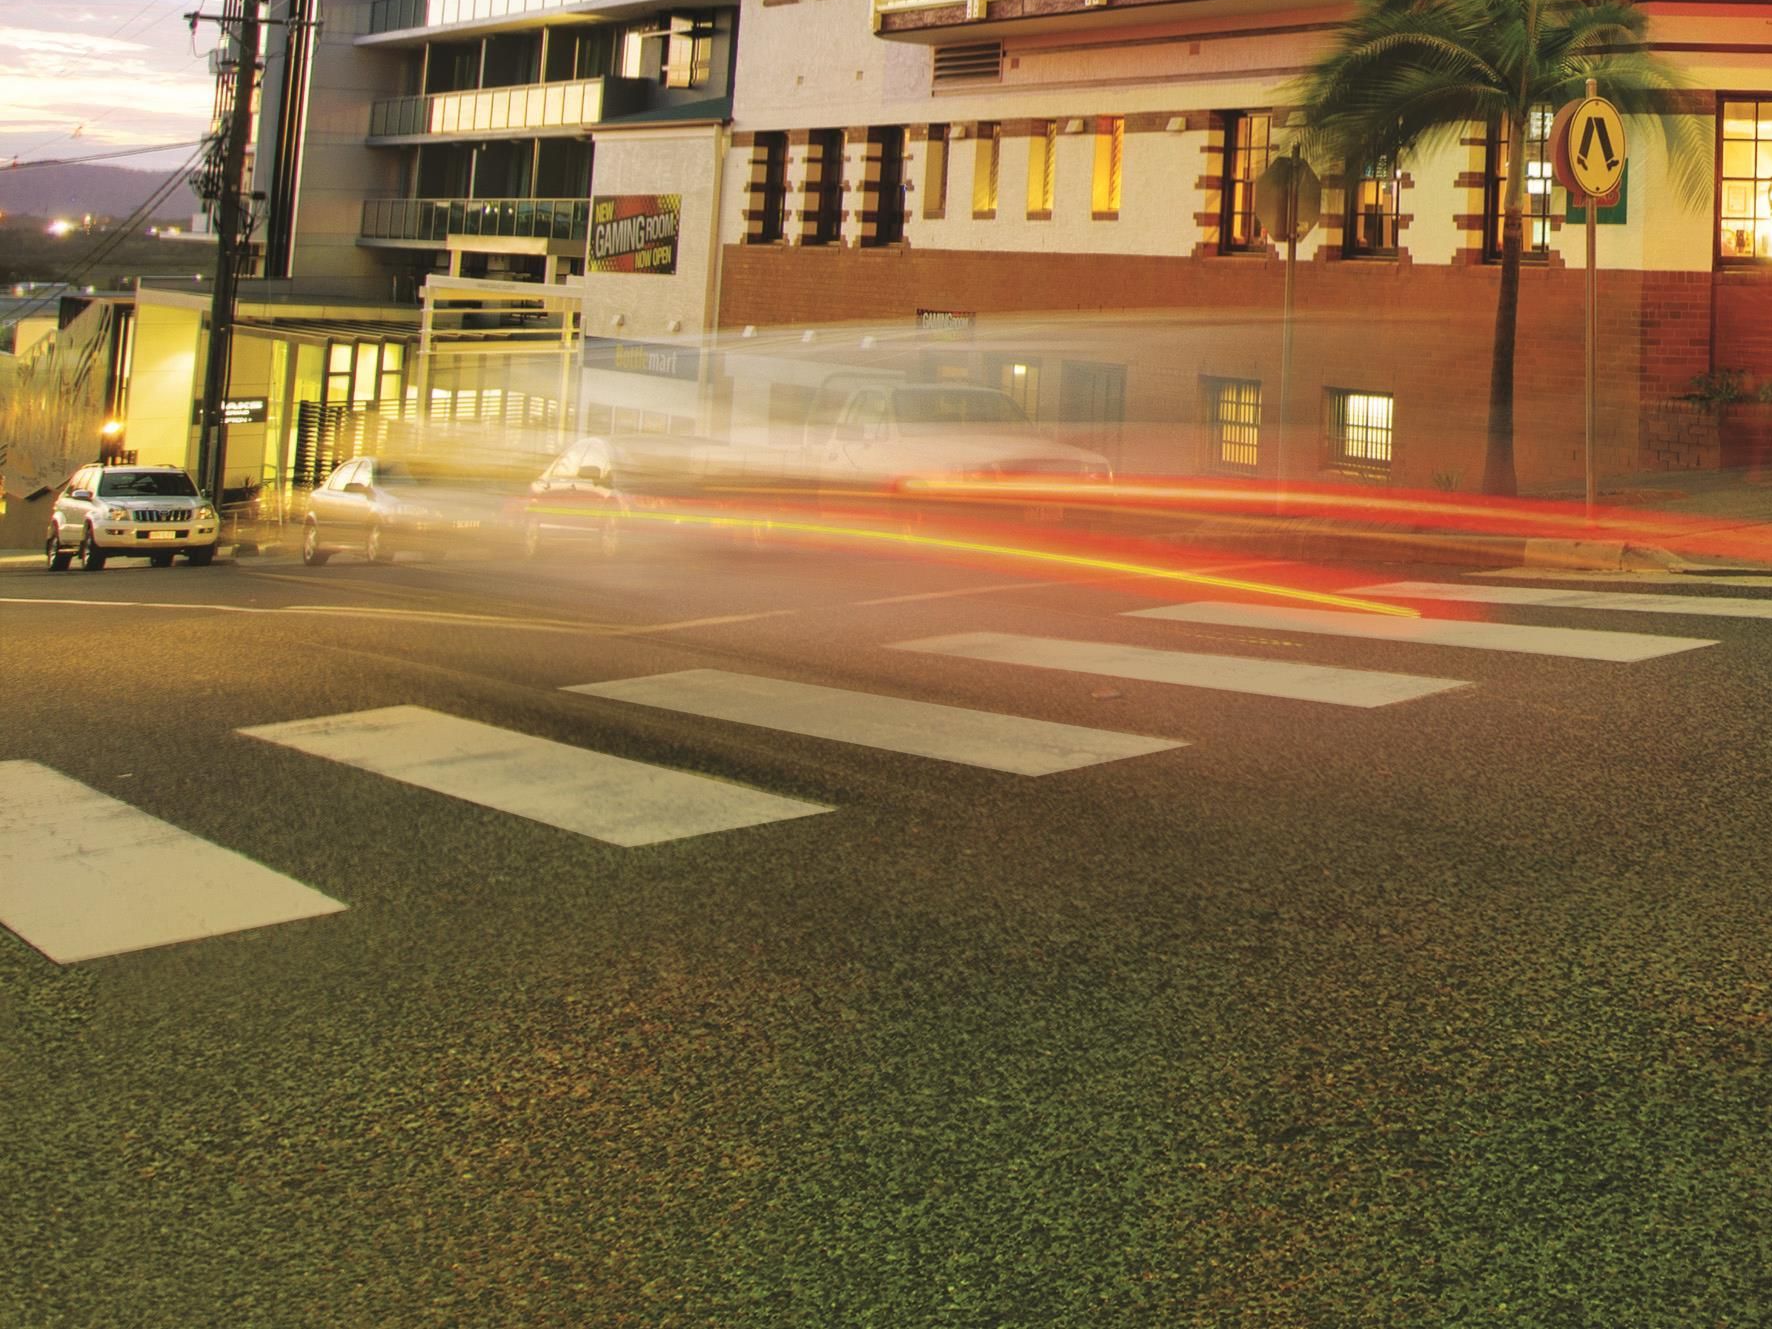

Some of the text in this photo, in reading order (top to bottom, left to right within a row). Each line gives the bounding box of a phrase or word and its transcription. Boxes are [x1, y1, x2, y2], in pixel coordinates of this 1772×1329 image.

[597, 201, 614, 222] NEW
[596, 214, 674, 257] GAMING ROOM
[635, 246, 671, 267] NOW OPEN
